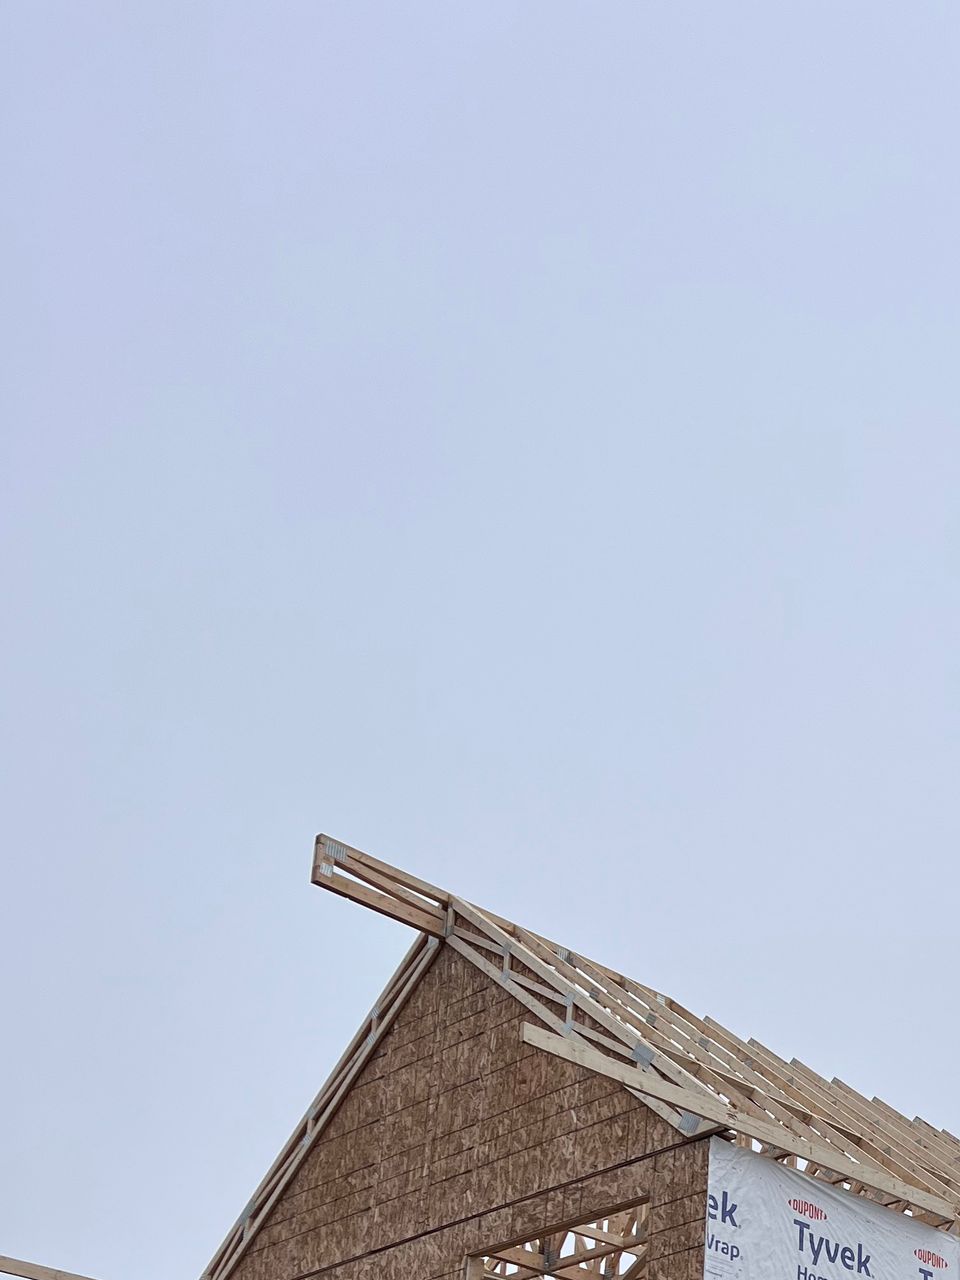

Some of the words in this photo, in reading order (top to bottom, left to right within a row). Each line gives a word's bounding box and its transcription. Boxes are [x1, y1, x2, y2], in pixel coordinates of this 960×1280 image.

[792, 1199, 824, 1220] DUPONT
[707, 1232, 740, 1261] Wrap
[794, 1219, 871, 1276] Tyvek
[918, 1249, 944, 1269] DUPONT
